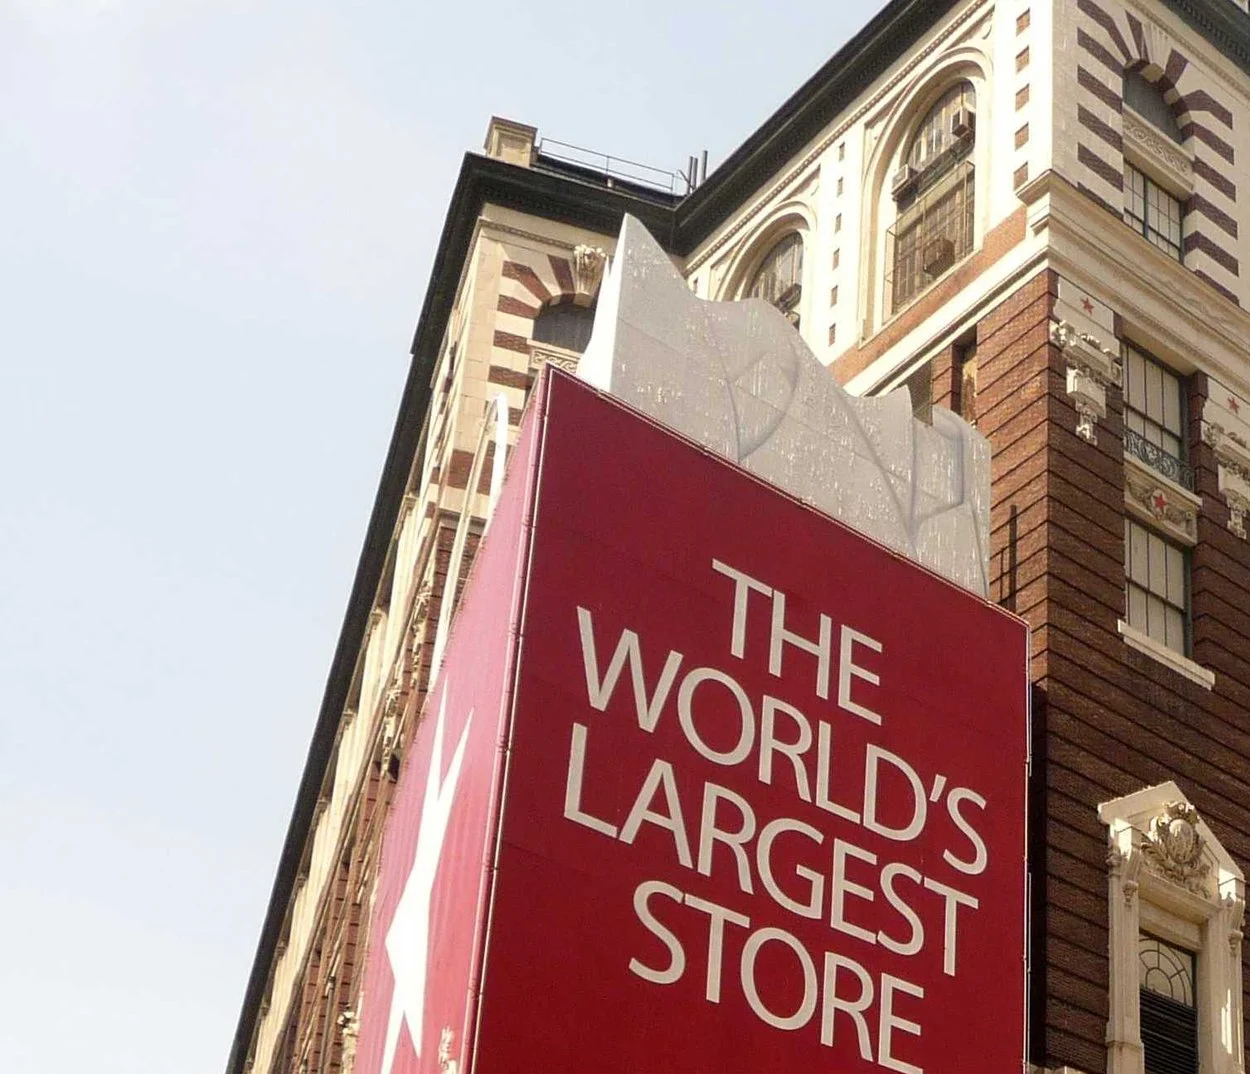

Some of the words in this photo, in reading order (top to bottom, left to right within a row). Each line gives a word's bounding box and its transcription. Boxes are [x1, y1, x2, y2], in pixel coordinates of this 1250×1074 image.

[575, 607, 988, 876] WORLD'S
[712, 559, 883, 726] THE
[563, 724, 978, 977] LARGEST
